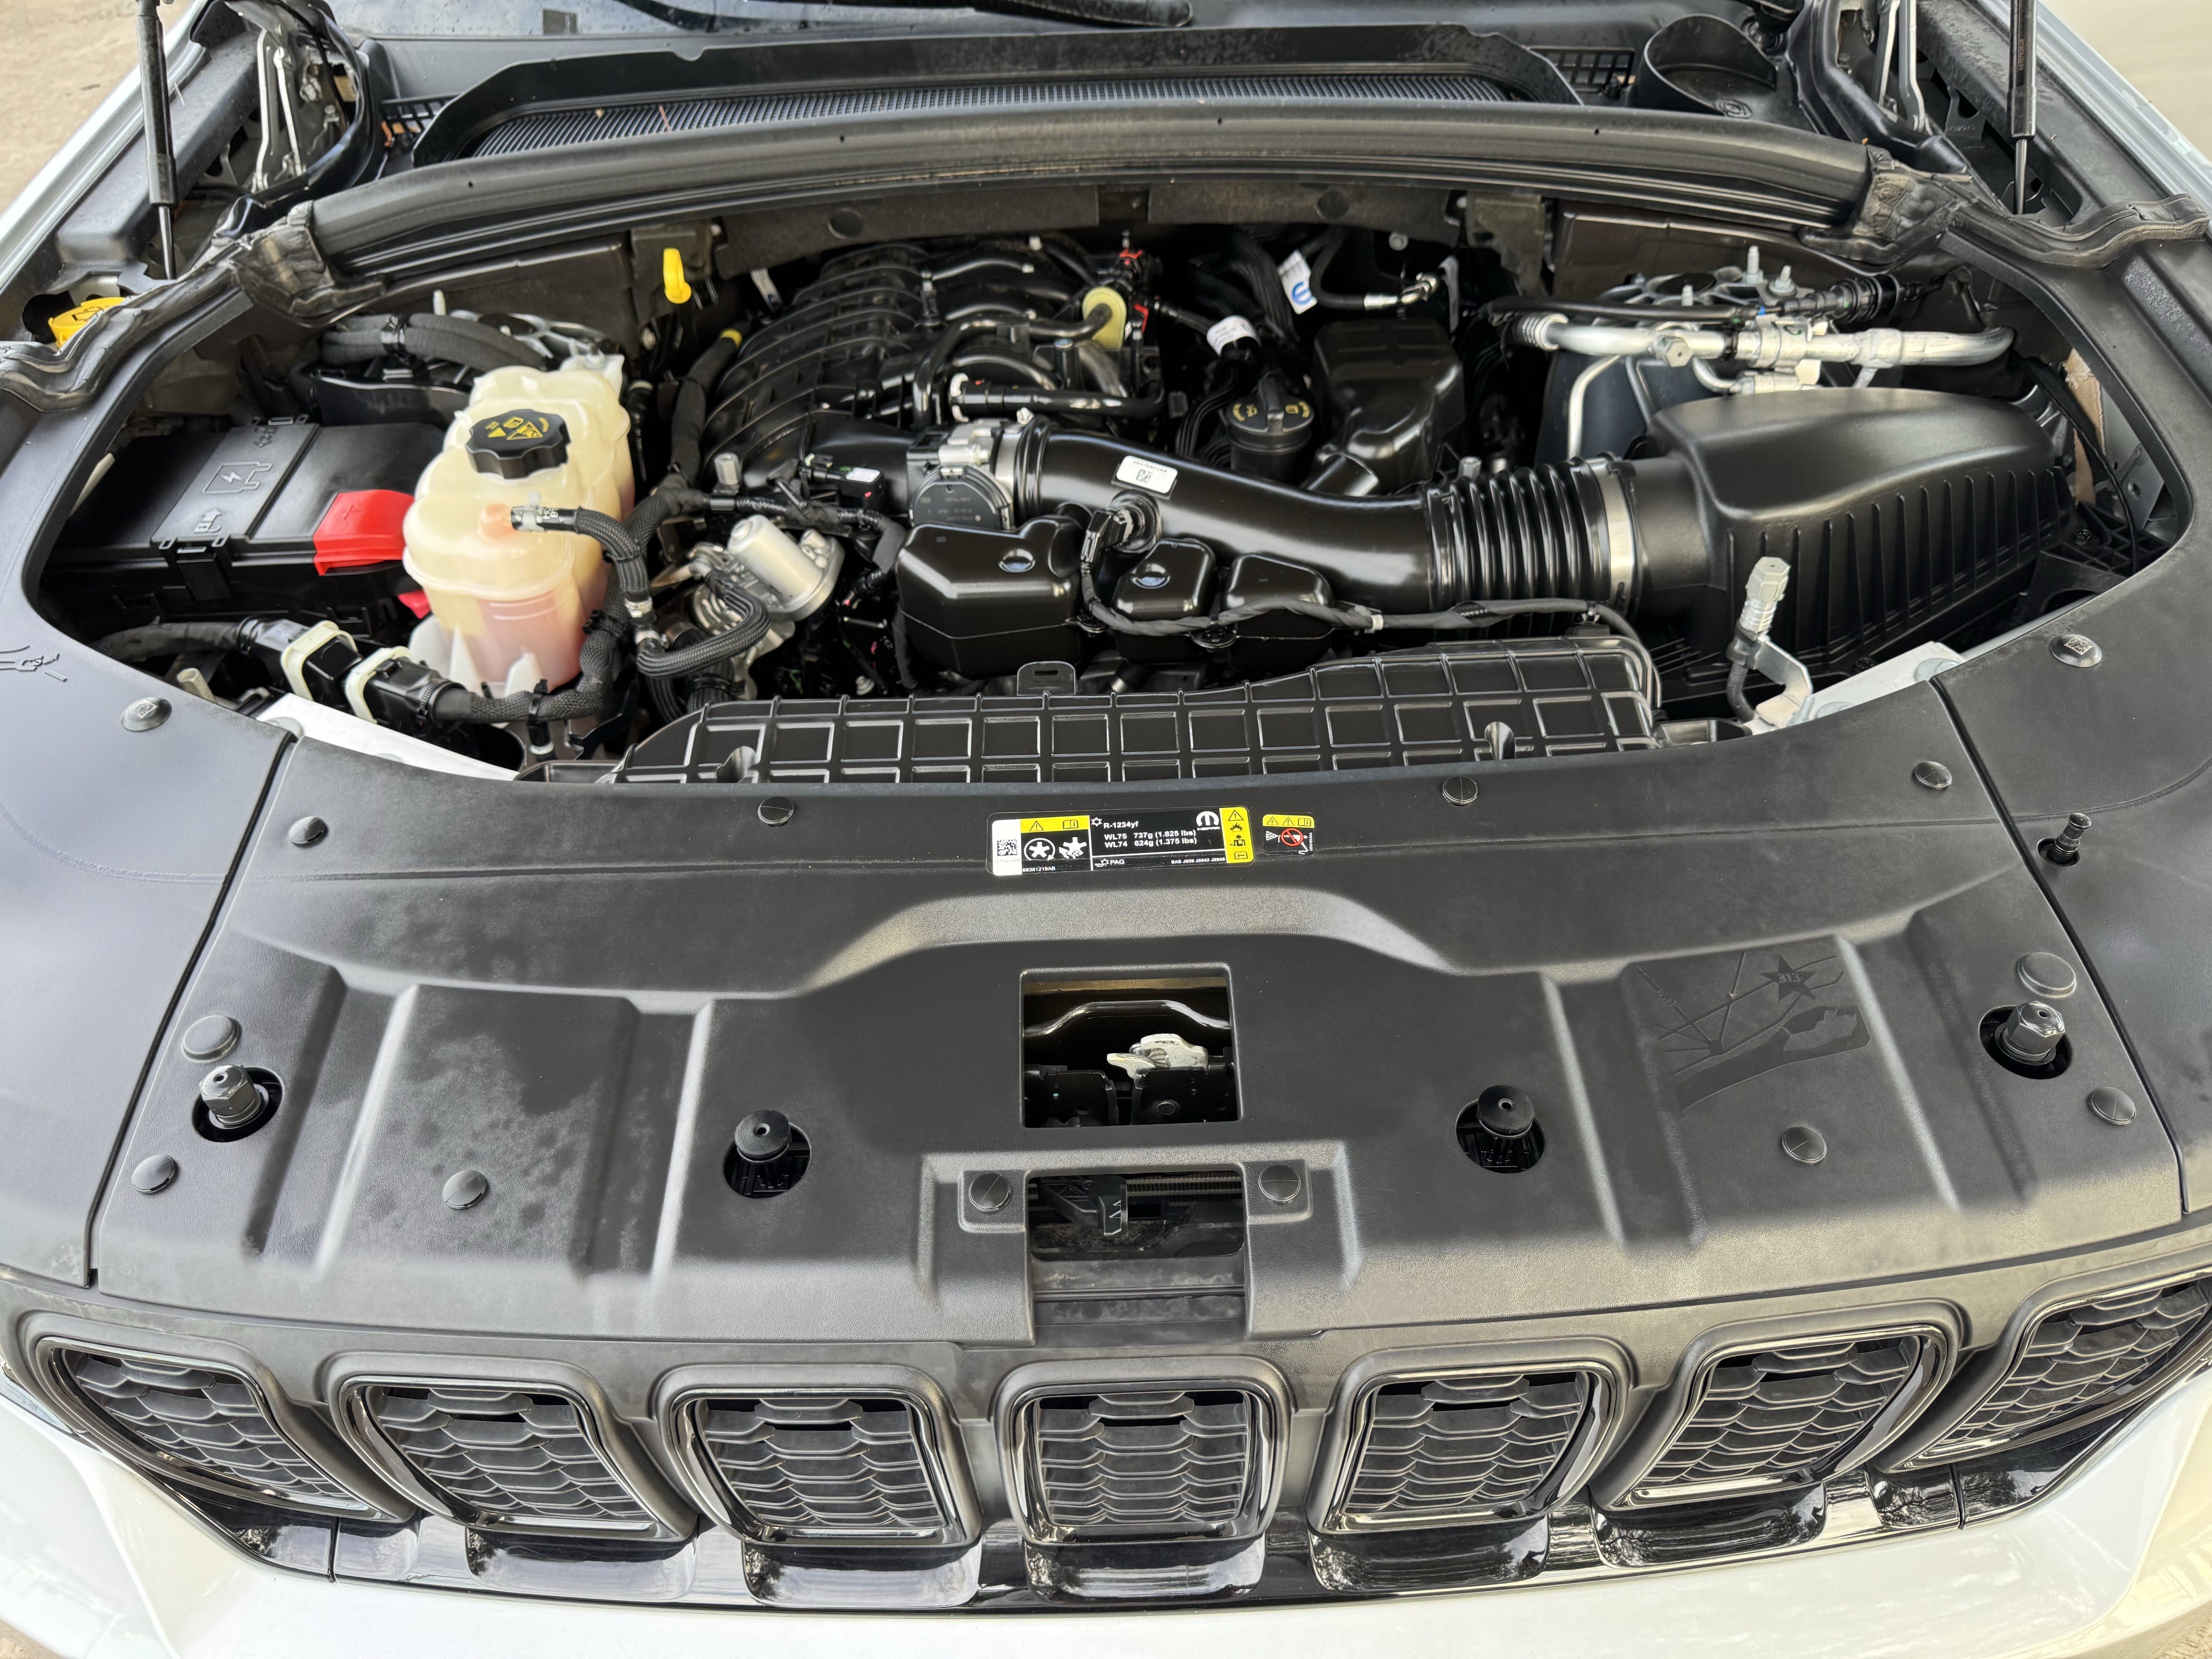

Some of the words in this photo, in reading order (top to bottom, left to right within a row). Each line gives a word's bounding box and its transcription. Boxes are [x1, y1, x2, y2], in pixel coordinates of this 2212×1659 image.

[1103, 821, 1139, 829] R-1234yf
[1156, 838, 1180, 847] (1.375
[1778, 972, 1802, 983] 313
